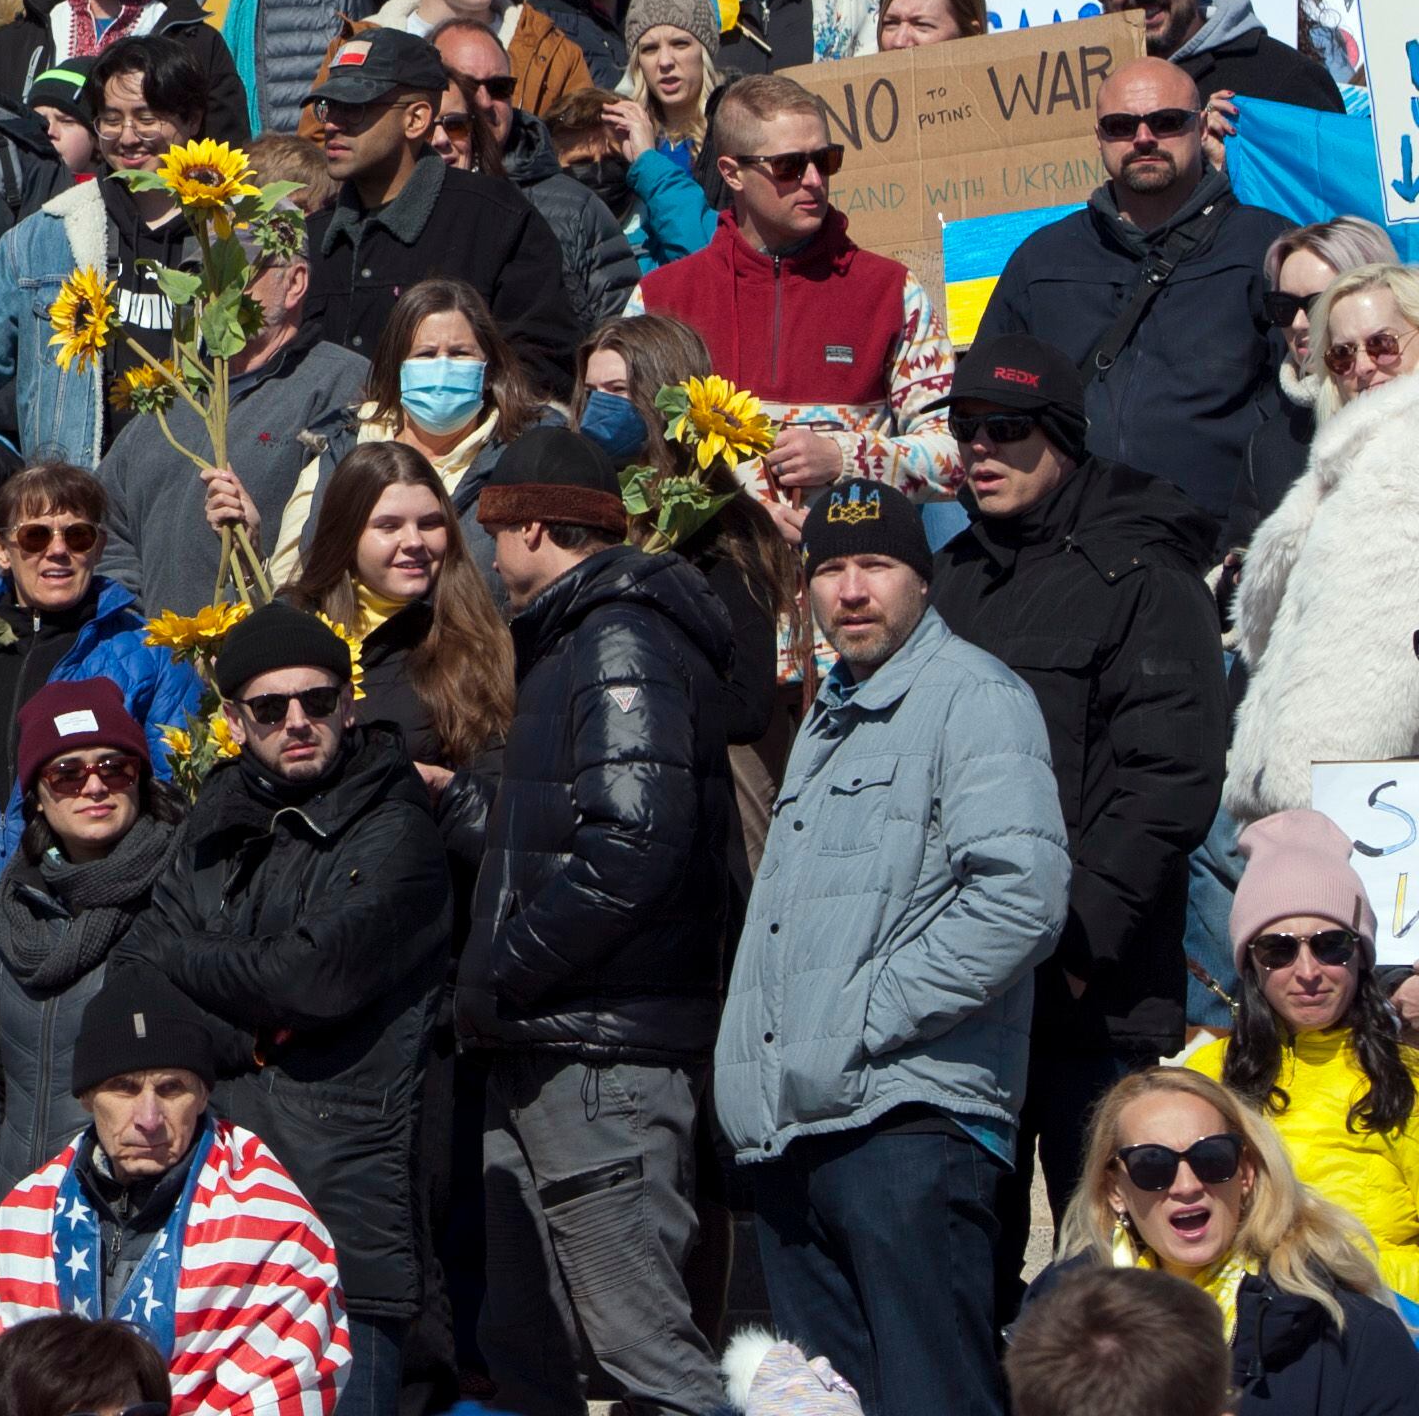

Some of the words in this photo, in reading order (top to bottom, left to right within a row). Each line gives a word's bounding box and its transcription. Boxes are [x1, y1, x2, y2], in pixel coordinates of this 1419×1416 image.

[816, 78, 899, 151] NO
[986, 45, 1113, 122] WAR
[926, 86, 947, 100] TO
[831, 182, 906, 216] TAND
[925, 177, 986, 206] WITH
[1002, 158, 1109, 198] UKRAIN
[994, 366, 1040, 388] REDX
